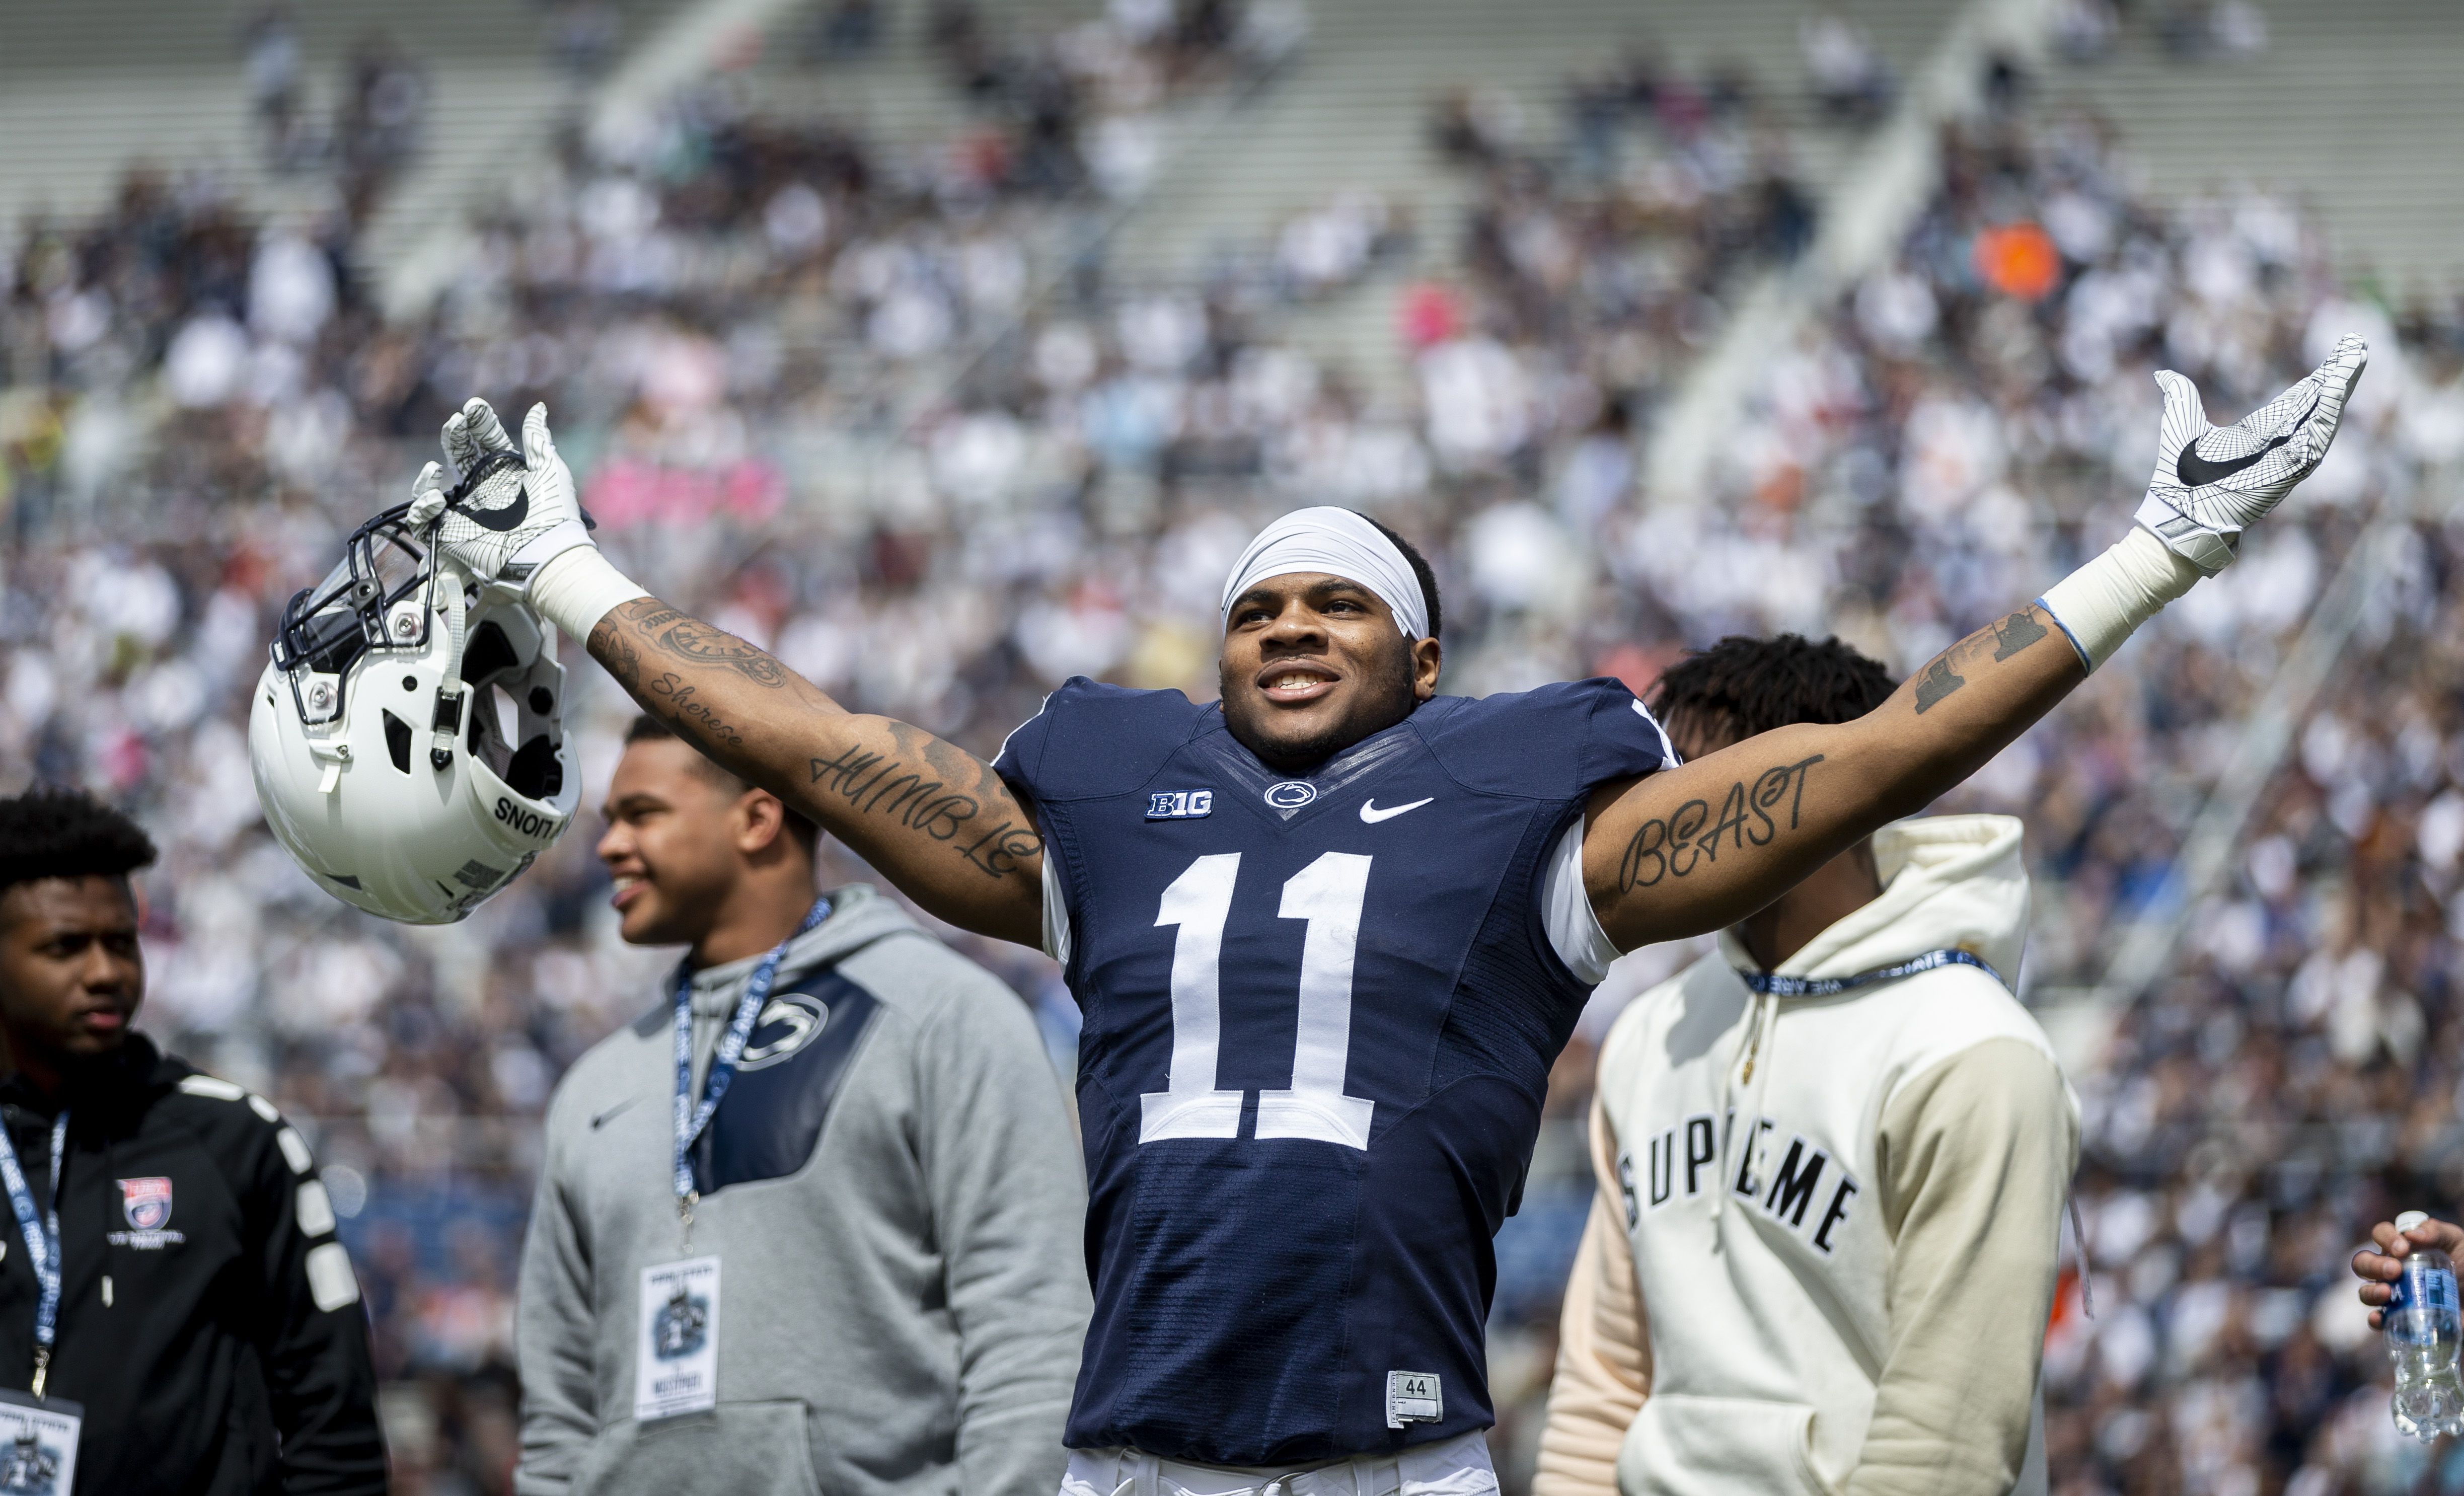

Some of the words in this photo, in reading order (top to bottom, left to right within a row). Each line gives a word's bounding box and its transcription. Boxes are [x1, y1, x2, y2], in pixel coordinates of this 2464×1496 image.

[651, 672, 742, 746] Sherese
[495, 797, 553, 840] LIONS
[810, 743, 1042, 878] HUMBLE
[1619, 754, 1825, 894] BEAST
[1139, 851, 1375, 1151] 11
[1406, 1379, 1426, 1395] 44
